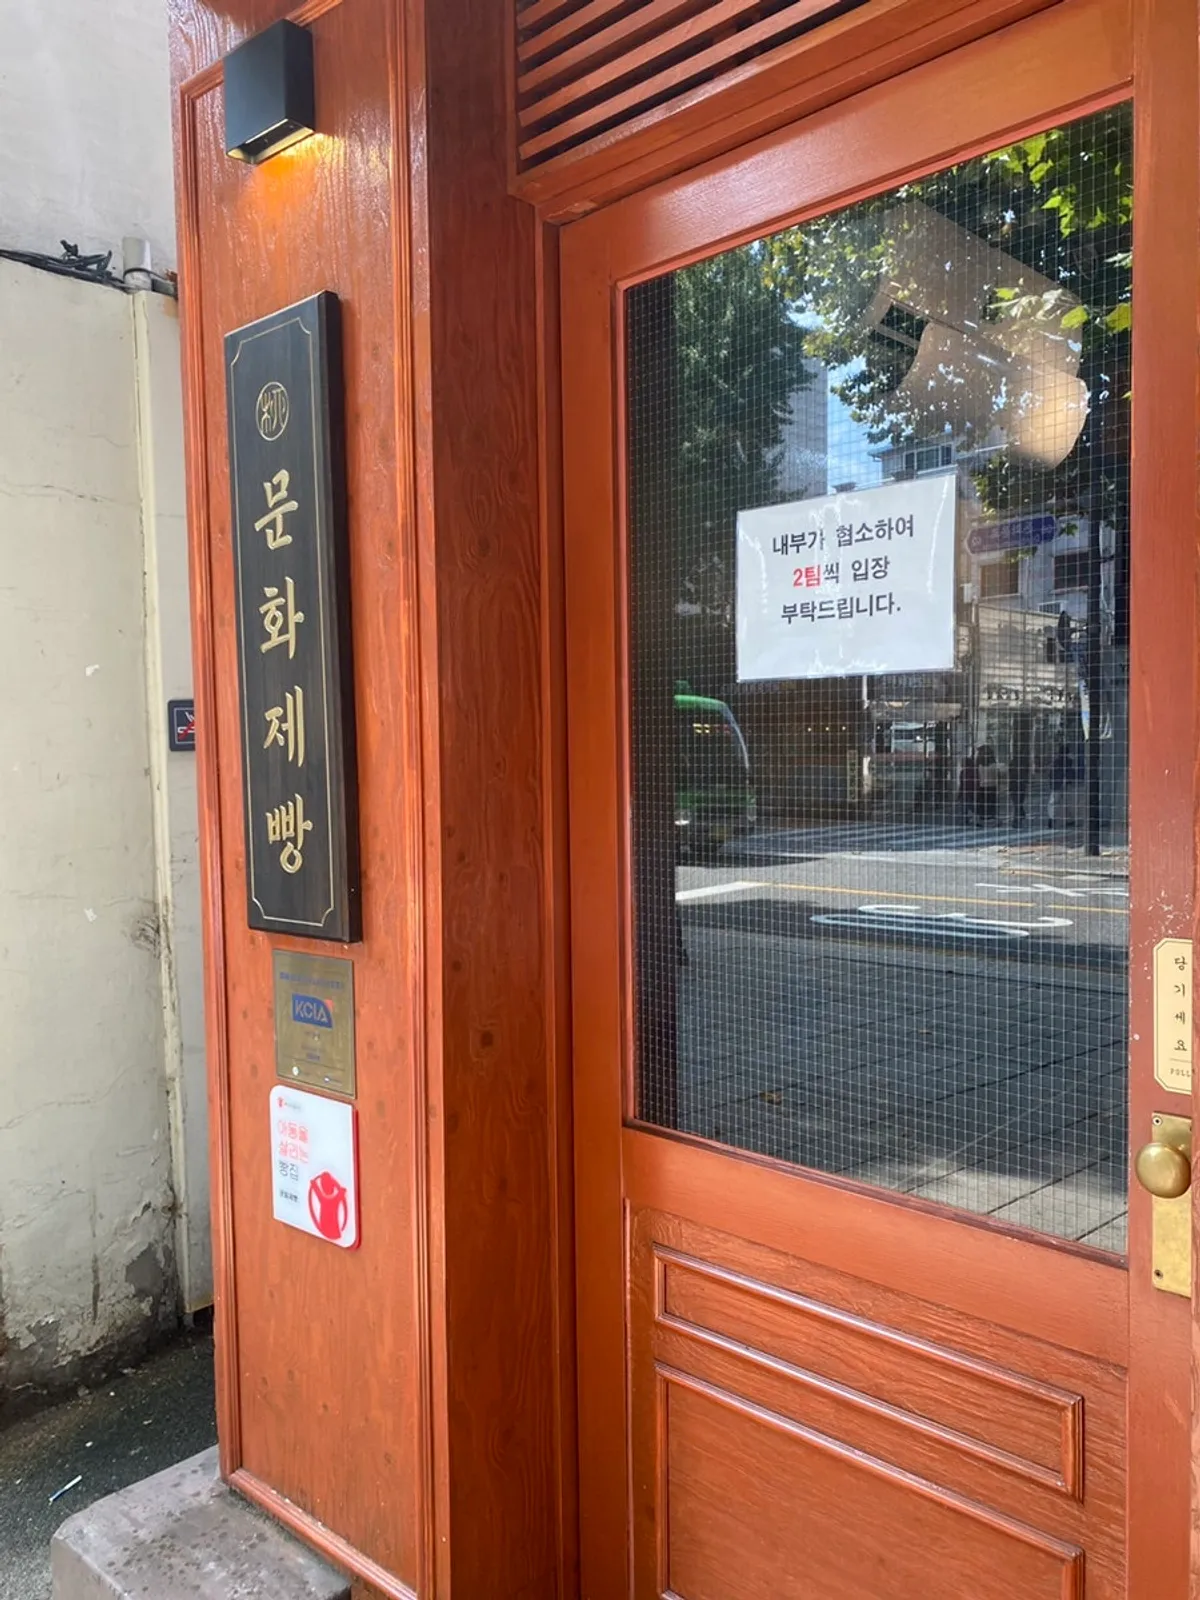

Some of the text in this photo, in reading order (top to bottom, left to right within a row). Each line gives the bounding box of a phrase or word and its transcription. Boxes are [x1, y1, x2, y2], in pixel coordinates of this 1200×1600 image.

[773, 514, 914, 556] 내부가 협소하여
[793, 555, 890, 588] 2팀씩 입장
[781, 592, 901, 624] 부탁드립니다.
[253, 468, 313, 874] 문화제빵
[295, 1000, 328, 1023] KCIA
[1174, 955, 1188, 1052] 당기세요
[1170, 1067, 1191, 1078] PULL
